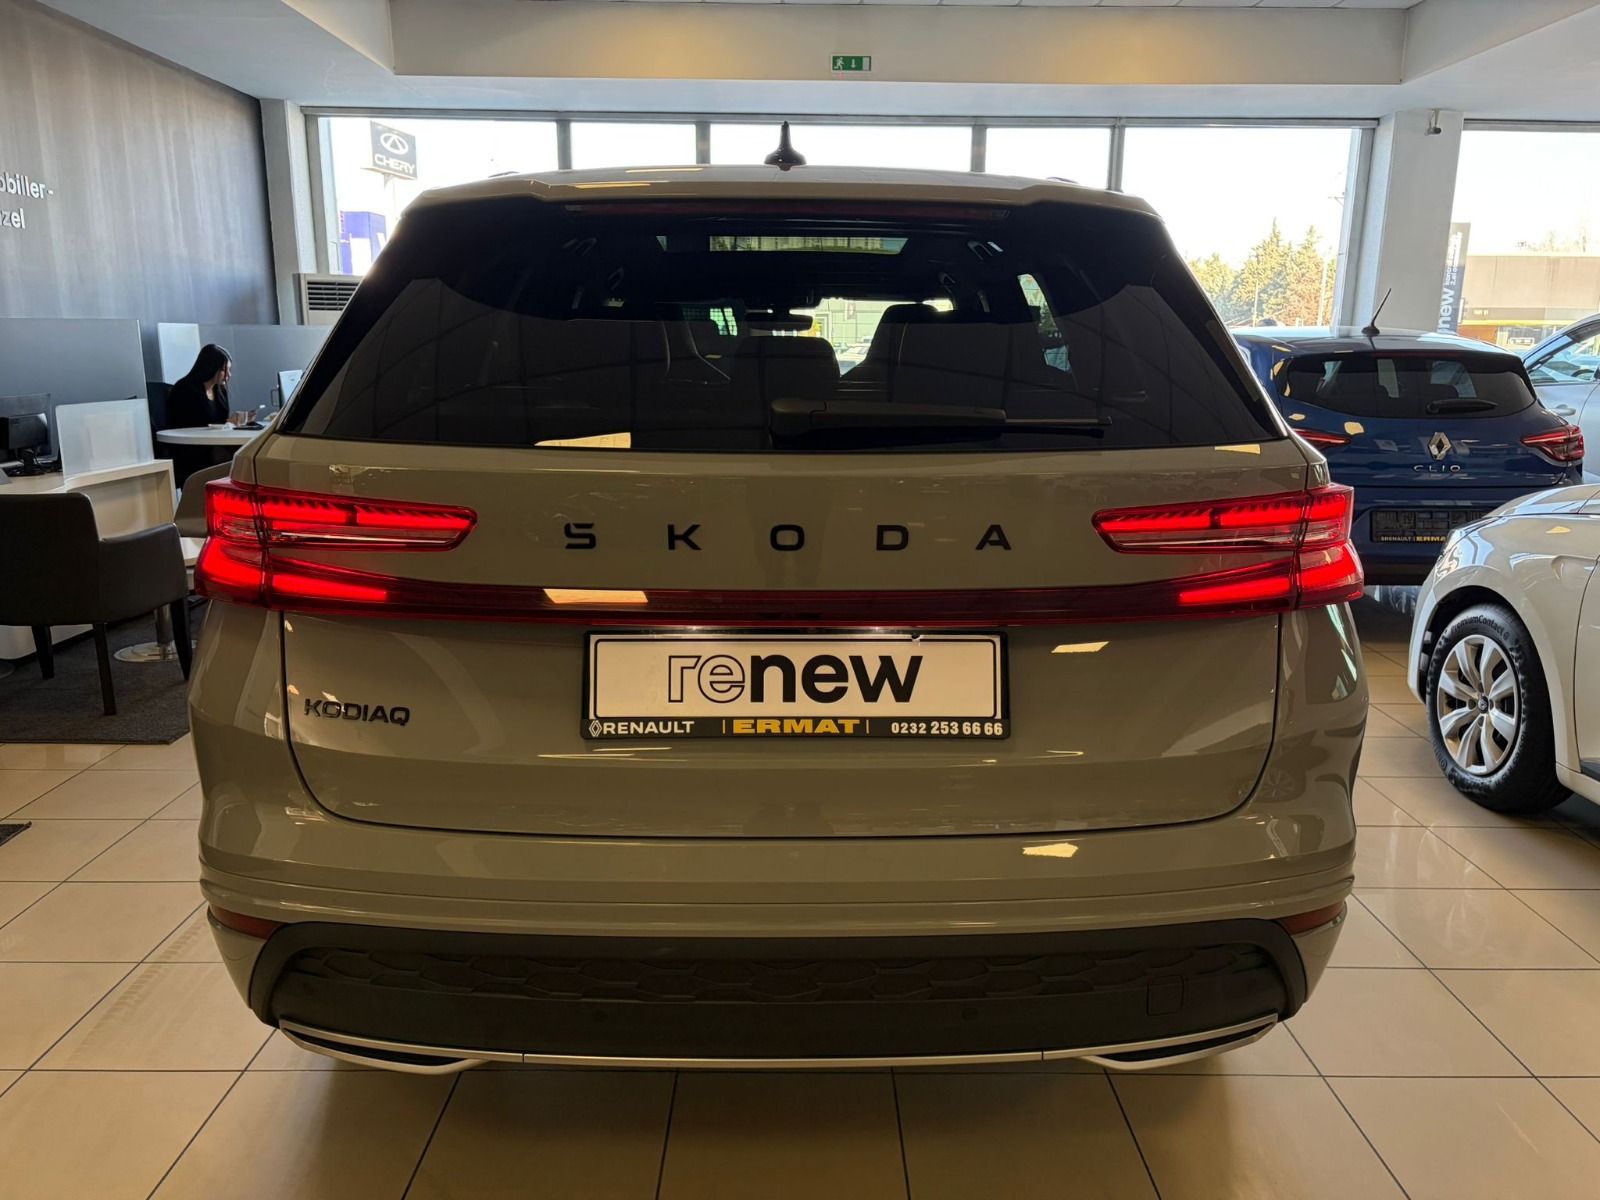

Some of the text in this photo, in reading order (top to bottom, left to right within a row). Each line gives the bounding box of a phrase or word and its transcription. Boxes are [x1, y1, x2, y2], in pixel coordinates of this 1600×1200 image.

[375, 153, 415, 174] CHERY
[0, 207, 26, 229] zel
[1437, 287, 1455, 333] new
[563, 522, 1012, 551] SKODA
[667, 653, 923, 704] renew
[304, 698, 410, 726] KODIAQ
[602, 719, 1003, 736] RENAULT ERMAT 0232 253 66 66
